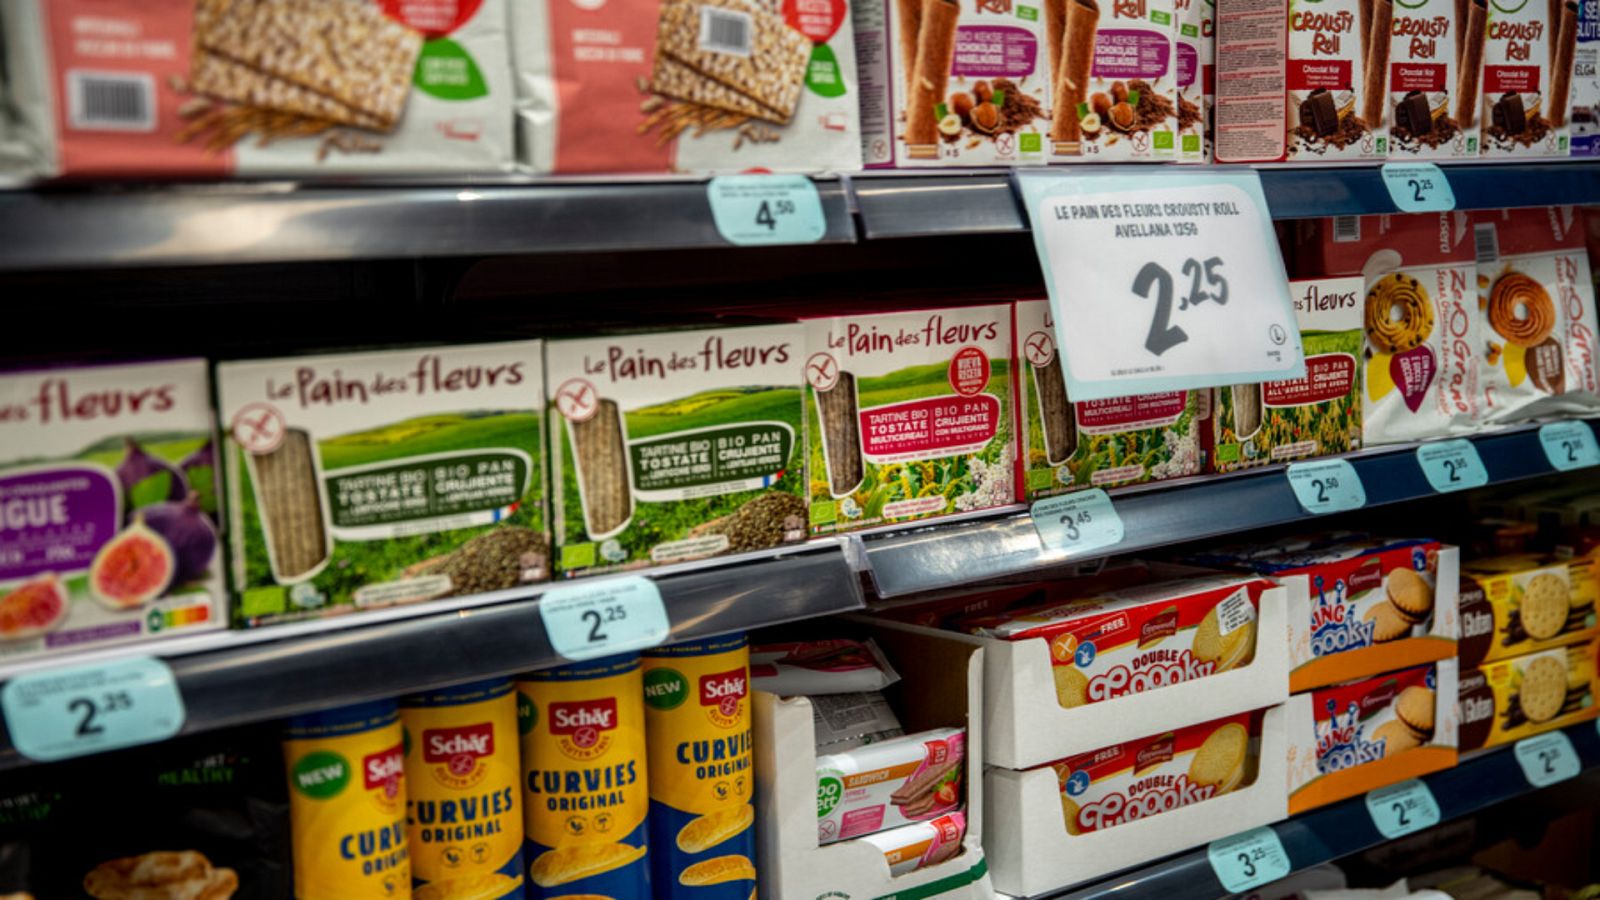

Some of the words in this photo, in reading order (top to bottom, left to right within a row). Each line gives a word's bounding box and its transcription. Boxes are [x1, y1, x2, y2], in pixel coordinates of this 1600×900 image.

[1291, 11, 1354, 34] CROUSTY
[1391, 16, 1450, 38] CROUSTY
[1488, 20, 1544, 41] CROUSTY
[1312, 33, 1340, 56] Roll
[1409, 38, 1436, 60] Roll
[1506, 41, 1531, 62] Roll
[1055, 206, 1068, 220] LE
[1071, 204, 1100, 220] PAIN
[1101, 203, 1122, 219] DES
[1124, 203, 1163, 218] FLEURS
[1163, 202, 1210, 217] CROUSTY
[1214, 201, 1240, 216] ROLL
[1115, 223, 1171, 238] AVELLANA
[1173, 222, 1199, 237] 125G
[1131, 256, 1229, 357] 2,25
[1303, 284, 1356, 313] fleurs
[828, 332, 845, 349] Le
[847, 323, 894, 356] Pain
[895, 328, 920, 346] des
[921, 315, 999, 347] fleurs
[584, 355, 607, 375] Le
[608, 346, 666, 383] Pain
[667, 352, 697, 372] des
[698, 335, 791, 372] fleurs
[1332, 361, 1349, 370] PAN
[266, 377, 295, 400] Le
[296, 366, 369, 408] Pain
[370, 372, 408, 395] des
[409, 355, 526, 395] fleurs
[32, 379, 176, 424] fleurs
[934, 406, 958, 417] BIO
[964, 402, 990, 413] PAN
[869, 410, 909, 425] TARTINE
[911, 408, 929, 419] BIO
[934, 412, 990, 428] CRUJIENTE
[870, 419, 928, 436] TOSTATE
[640, 442, 688, 458] TARTINE
[690, 439, 711, 453] BIO
[718, 435, 745, 450] BIO
[752, 431, 782, 444] PAN
[640, 451, 709, 471] TOSTATE
[718, 443, 782, 461] CRUJIENTE
[434, 464, 470, 481] BIO
[477, 459, 515, 475] PAN
[1100, 617, 1126, 634] FREE
[1132, 649, 1178, 670] DOUBLE
[646, 679, 681, 698] NEW
[705, 676, 745, 699] Schär
[555, 707, 612, 728] Schär
[430, 733, 490, 756] Schär
[1094, 746, 1119, 763] FREE
[298, 762, 344, 788] NEW
[528, 759, 637, 794] CURVIES
[1128, 774, 1175, 797] DOUBLE
[547, 790, 625, 812] ORIGINAL
[421, 818, 502, 844] ORIGINAL
